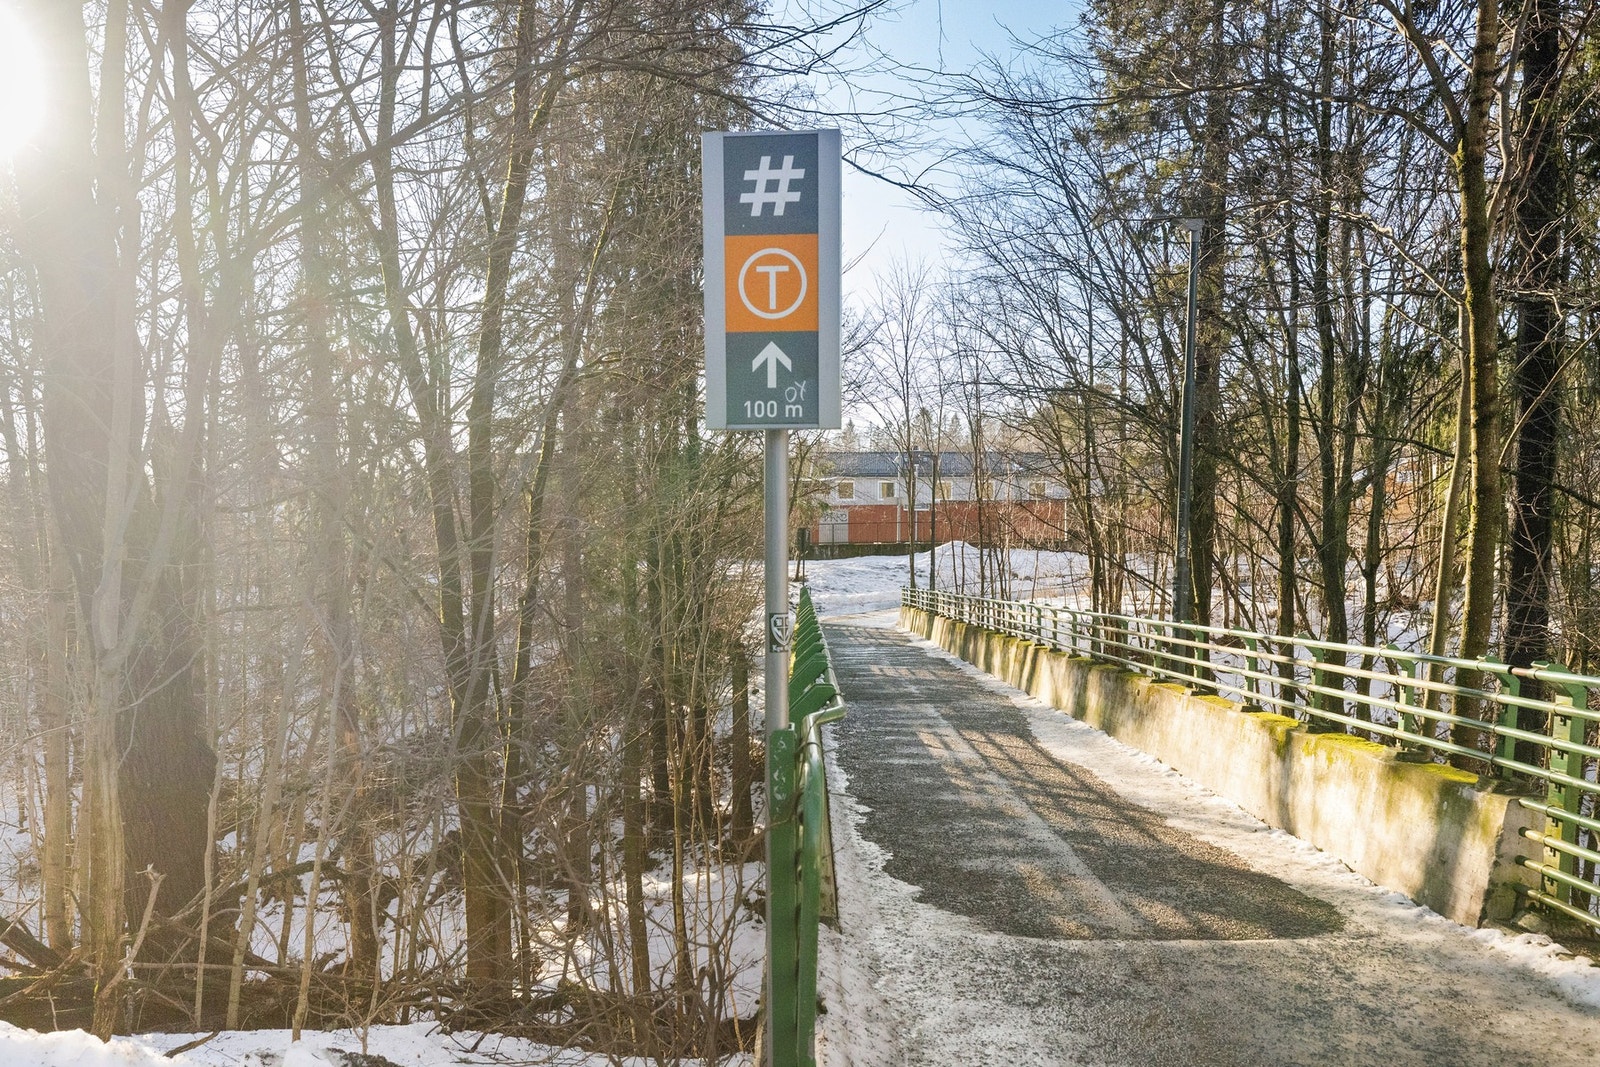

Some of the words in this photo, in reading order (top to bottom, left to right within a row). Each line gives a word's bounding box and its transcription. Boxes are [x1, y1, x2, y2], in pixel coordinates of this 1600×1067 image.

[756, 265, 789, 310] T
[743, 400, 778, 418] 100
[785, 404, 803, 418] m
